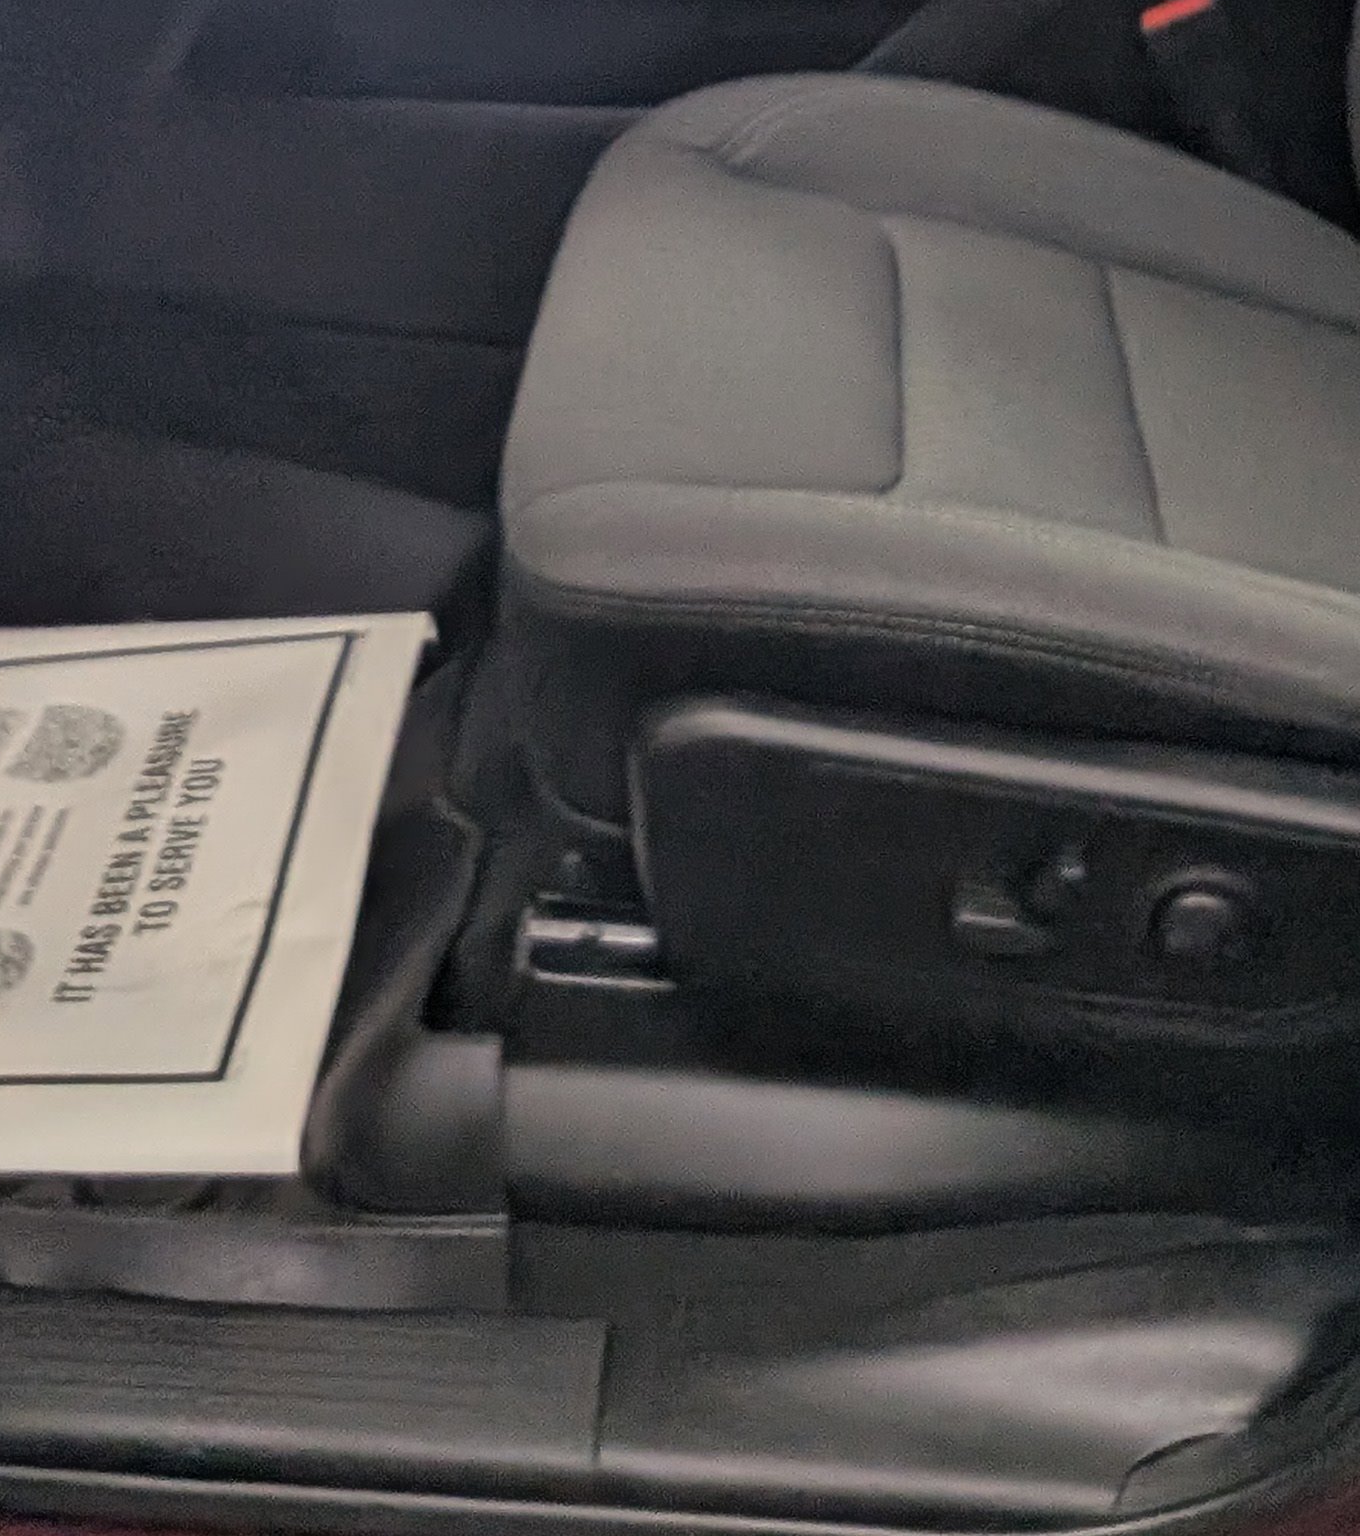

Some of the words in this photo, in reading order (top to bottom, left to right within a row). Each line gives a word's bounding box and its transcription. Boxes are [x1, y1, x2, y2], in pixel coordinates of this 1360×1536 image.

[125, 709, 199, 821] PLEASURE
[174, 758, 225, 807] YOU
[117, 826, 150, 842] A
[148, 815, 208, 891] SERVE
[90, 850, 143, 915] BEEN
[133, 900, 179, 935] TO
[64, 924, 122, 973] HAS
[51, 981, 95, 1002] IT
